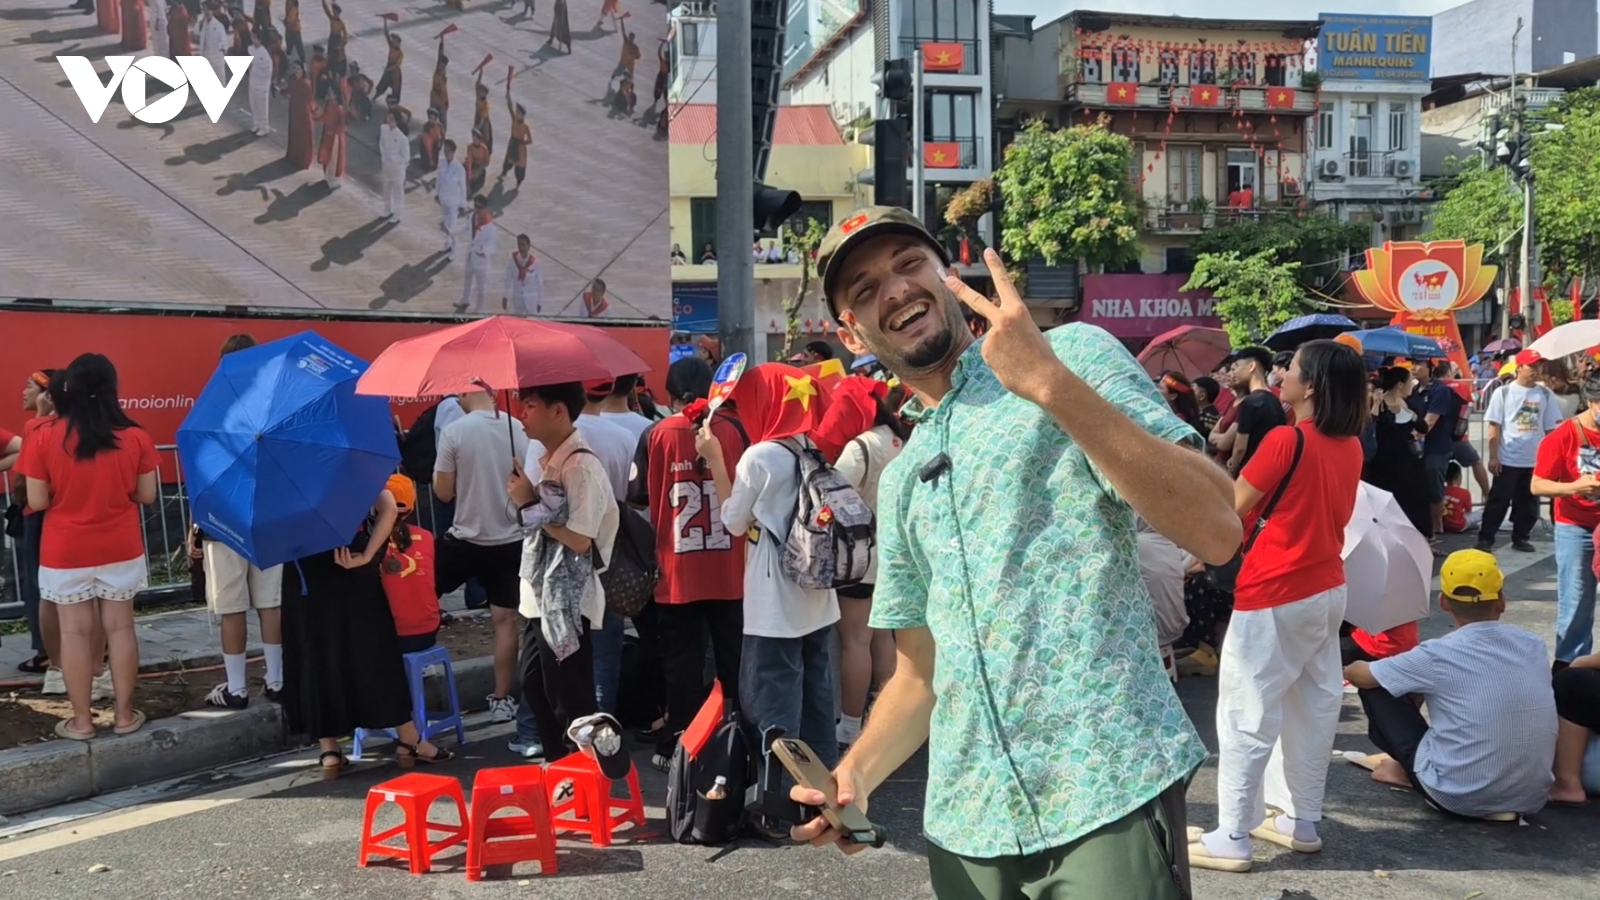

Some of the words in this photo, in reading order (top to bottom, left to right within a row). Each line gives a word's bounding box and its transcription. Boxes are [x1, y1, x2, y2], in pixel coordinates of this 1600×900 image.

[1325, 26, 1377, 52] TUẤN
[1384, 27, 1426, 53] TIẾN
[1333, 56, 1415, 68] MANNEQUINS
[1092, 299, 1135, 318] NHA
[1139, 299, 1194, 318] KHOA
[670, 460, 692, 472] Anh
[667, 479, 732, 554] 21
